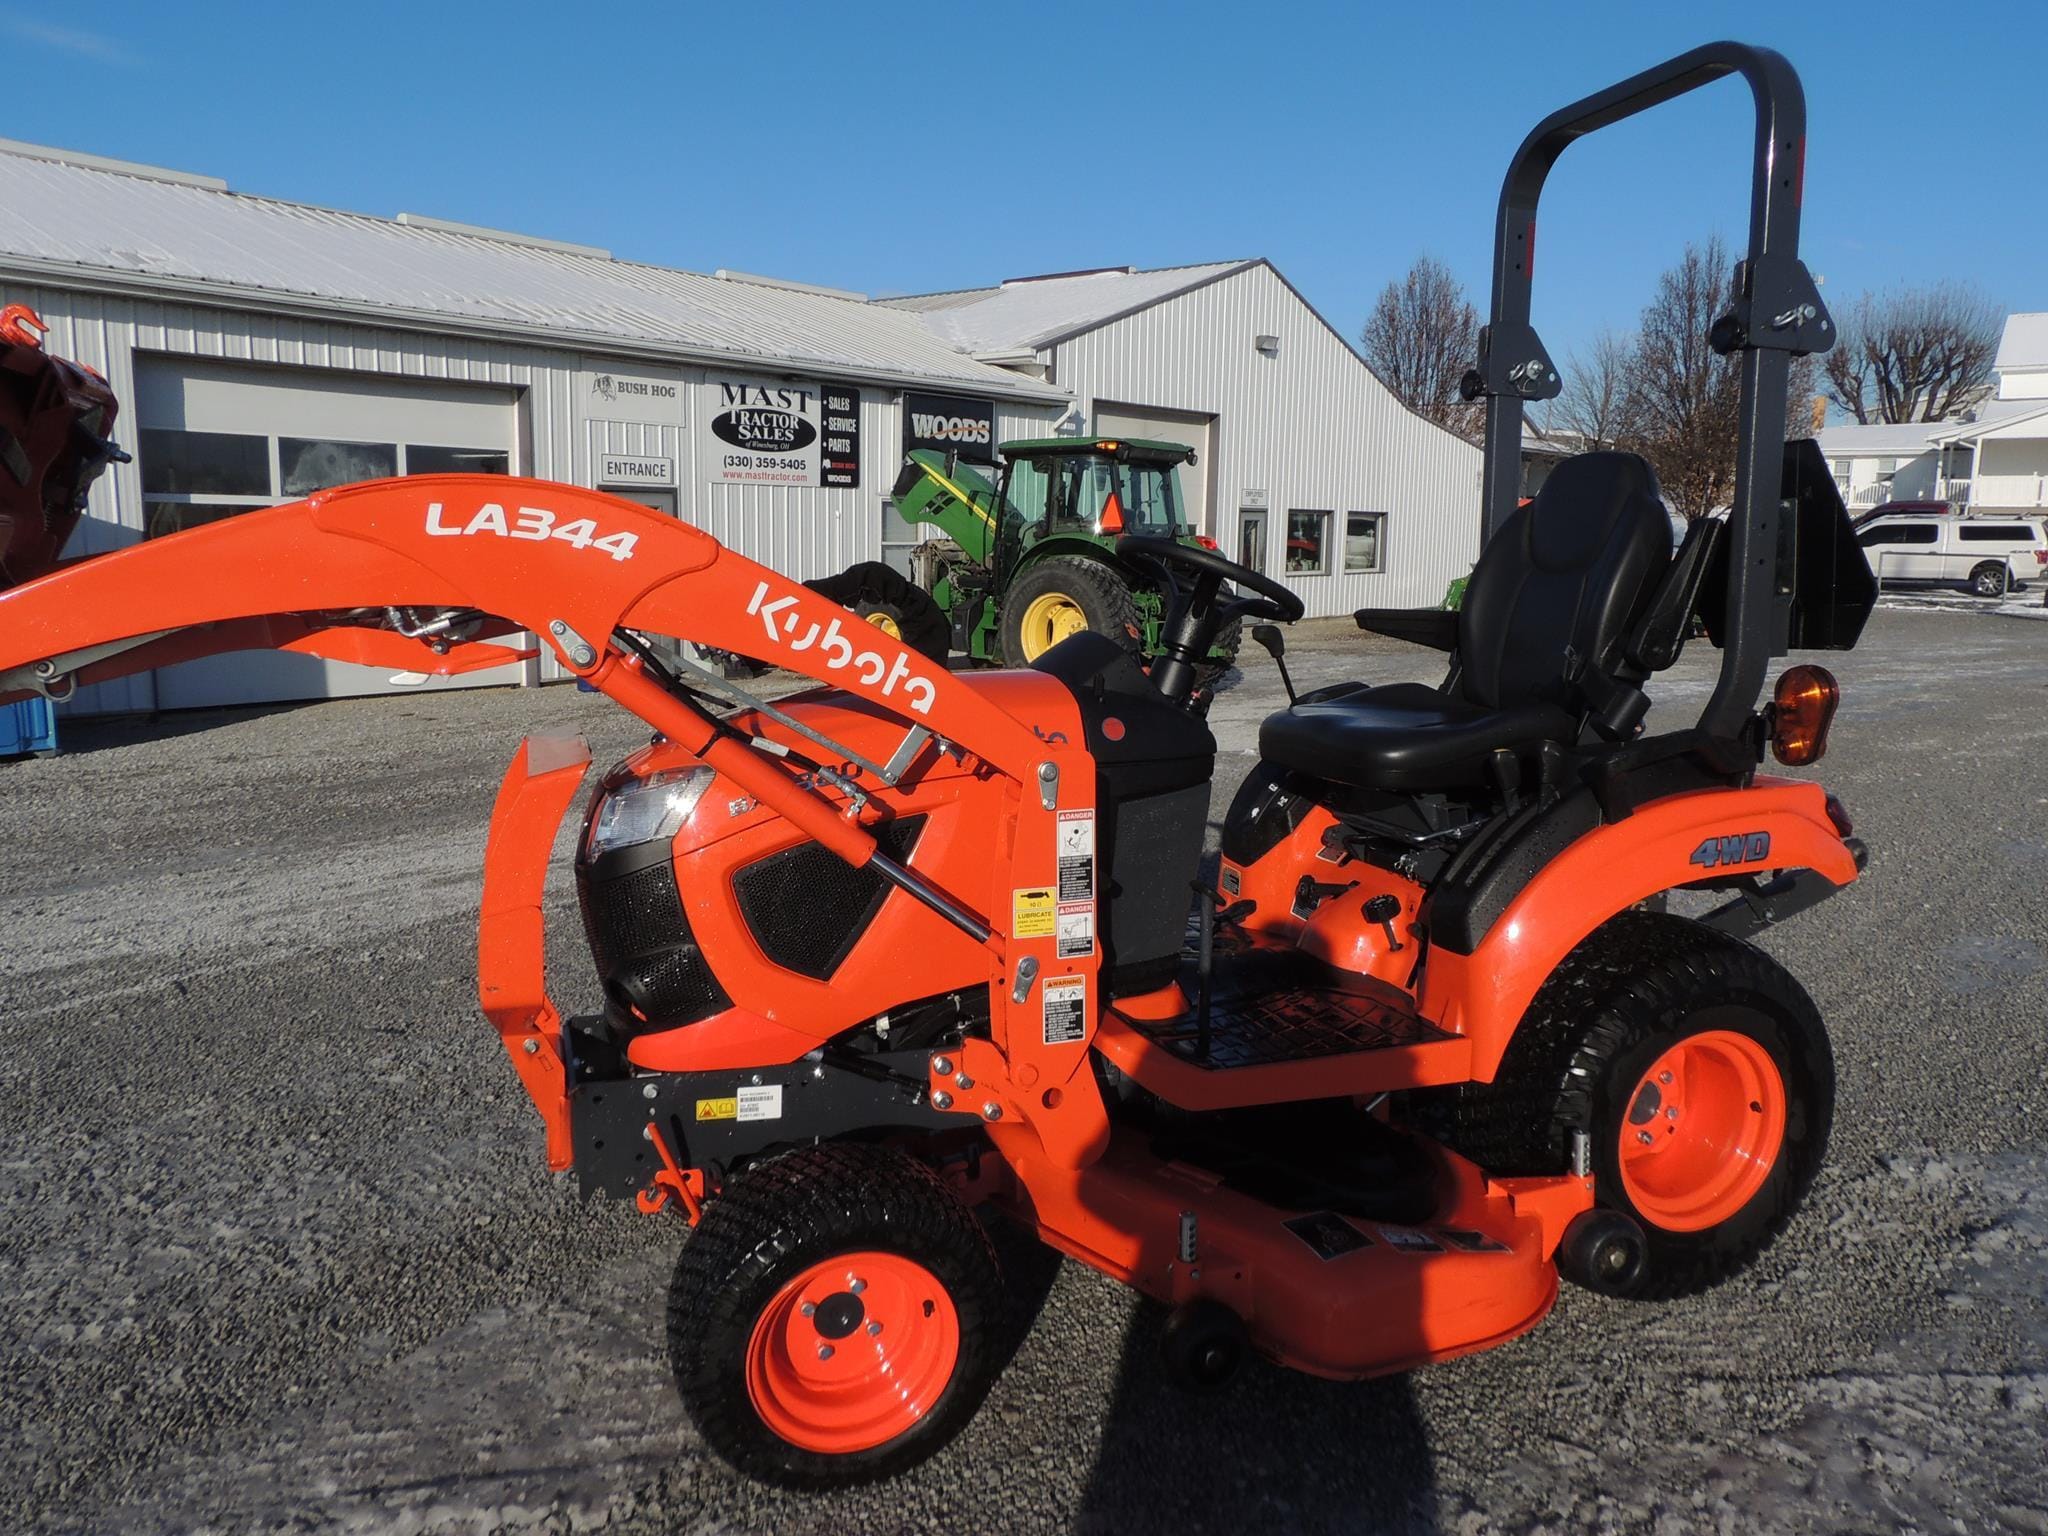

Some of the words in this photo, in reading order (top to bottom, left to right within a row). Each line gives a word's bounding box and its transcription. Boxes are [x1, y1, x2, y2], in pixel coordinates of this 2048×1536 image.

[617, 381, 648, 395] BUSH
[651, 384, 676, 398] HOG
[720, 382, 813, 414] MAST
[828, 396, 850, 411] SALES
[729, 408, 800, 430] TRACTOR
[828, 416, 857, 433] SERVICE
[738, 425, 795, 442] SALES
[911, 412, 990, 444] WOODS
[828, 438, 851, 453] PARTS
[607, 461, 667, 477] ENTRANCE
[723, 454, 753, 470] (330)
[755, 456, 807, 471] 359-5405
[722, 470, 808, 482] www.masttractor.com
[425, 502, 640, 562] LA344
[746, 581, 936, 715] Kubota
[1065, 812, 1092, 820] DANGER
[1689, 830, 1771, 868] 4WD
[1017, 911, 1052, 919] LUBRICATE
[1065, 904, 1092, 913] DANGER
[1053, 978, 1082, 987] WARNING
